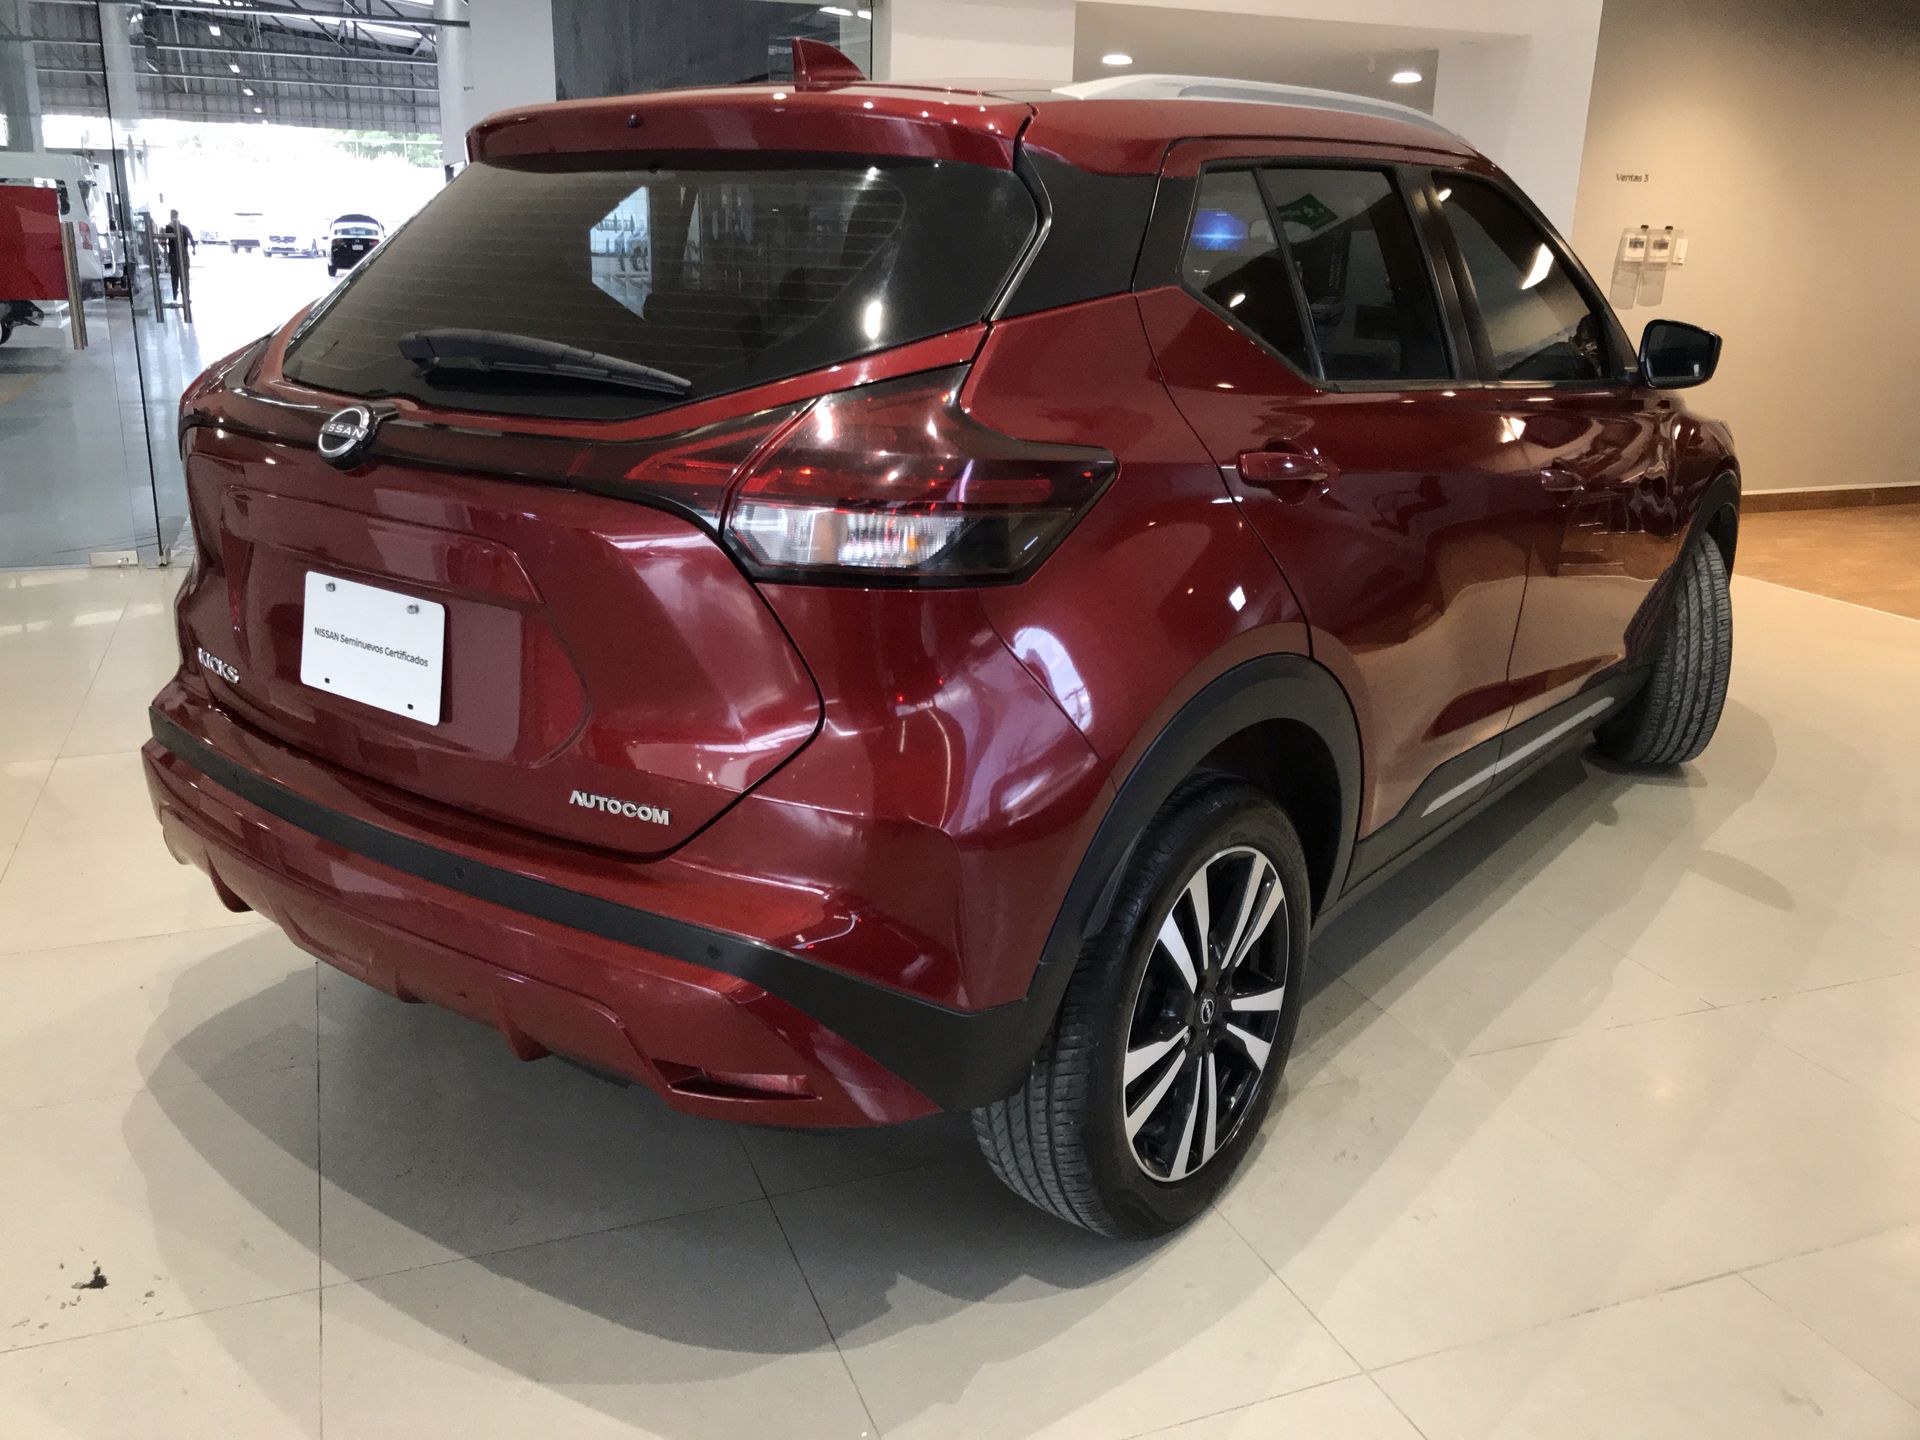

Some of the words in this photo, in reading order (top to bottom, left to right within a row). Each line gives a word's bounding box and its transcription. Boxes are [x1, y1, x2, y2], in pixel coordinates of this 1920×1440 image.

[327, 423, 365, 439] SSAN
[198, 647, 240, 684] KICKS
[314, 626, 340, 642] NISSAN
[340, 634, 384, 655] Seminuevos
[384, 646, 429, 668] Certificados
[569, 789, 670, 826] AUTOCOM
